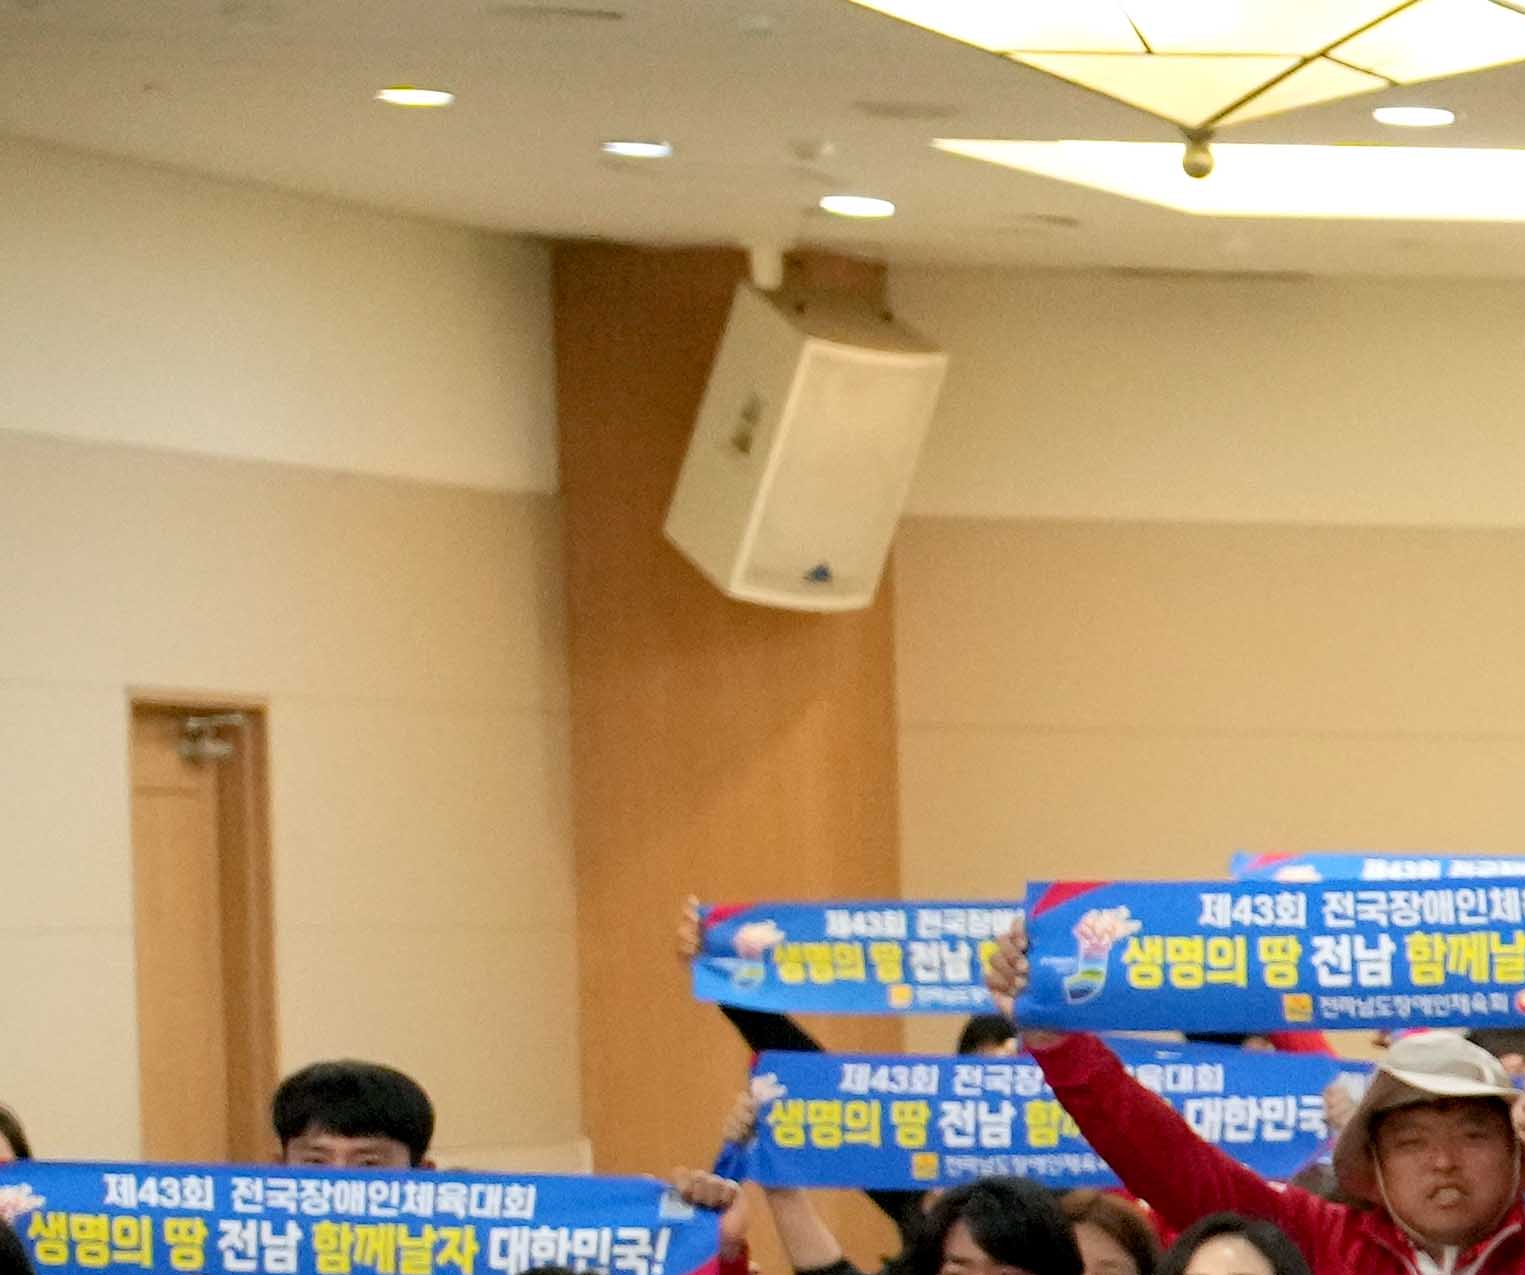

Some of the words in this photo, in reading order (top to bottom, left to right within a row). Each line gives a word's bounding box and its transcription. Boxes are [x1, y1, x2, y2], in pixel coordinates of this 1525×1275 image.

[1199, 892, 1306, 928] 제43회
[1117, 928, 1247, 989] 생명의
[1258, 935, 1302, 988] 땅
[1311, 934, 1396, 987] 전남
